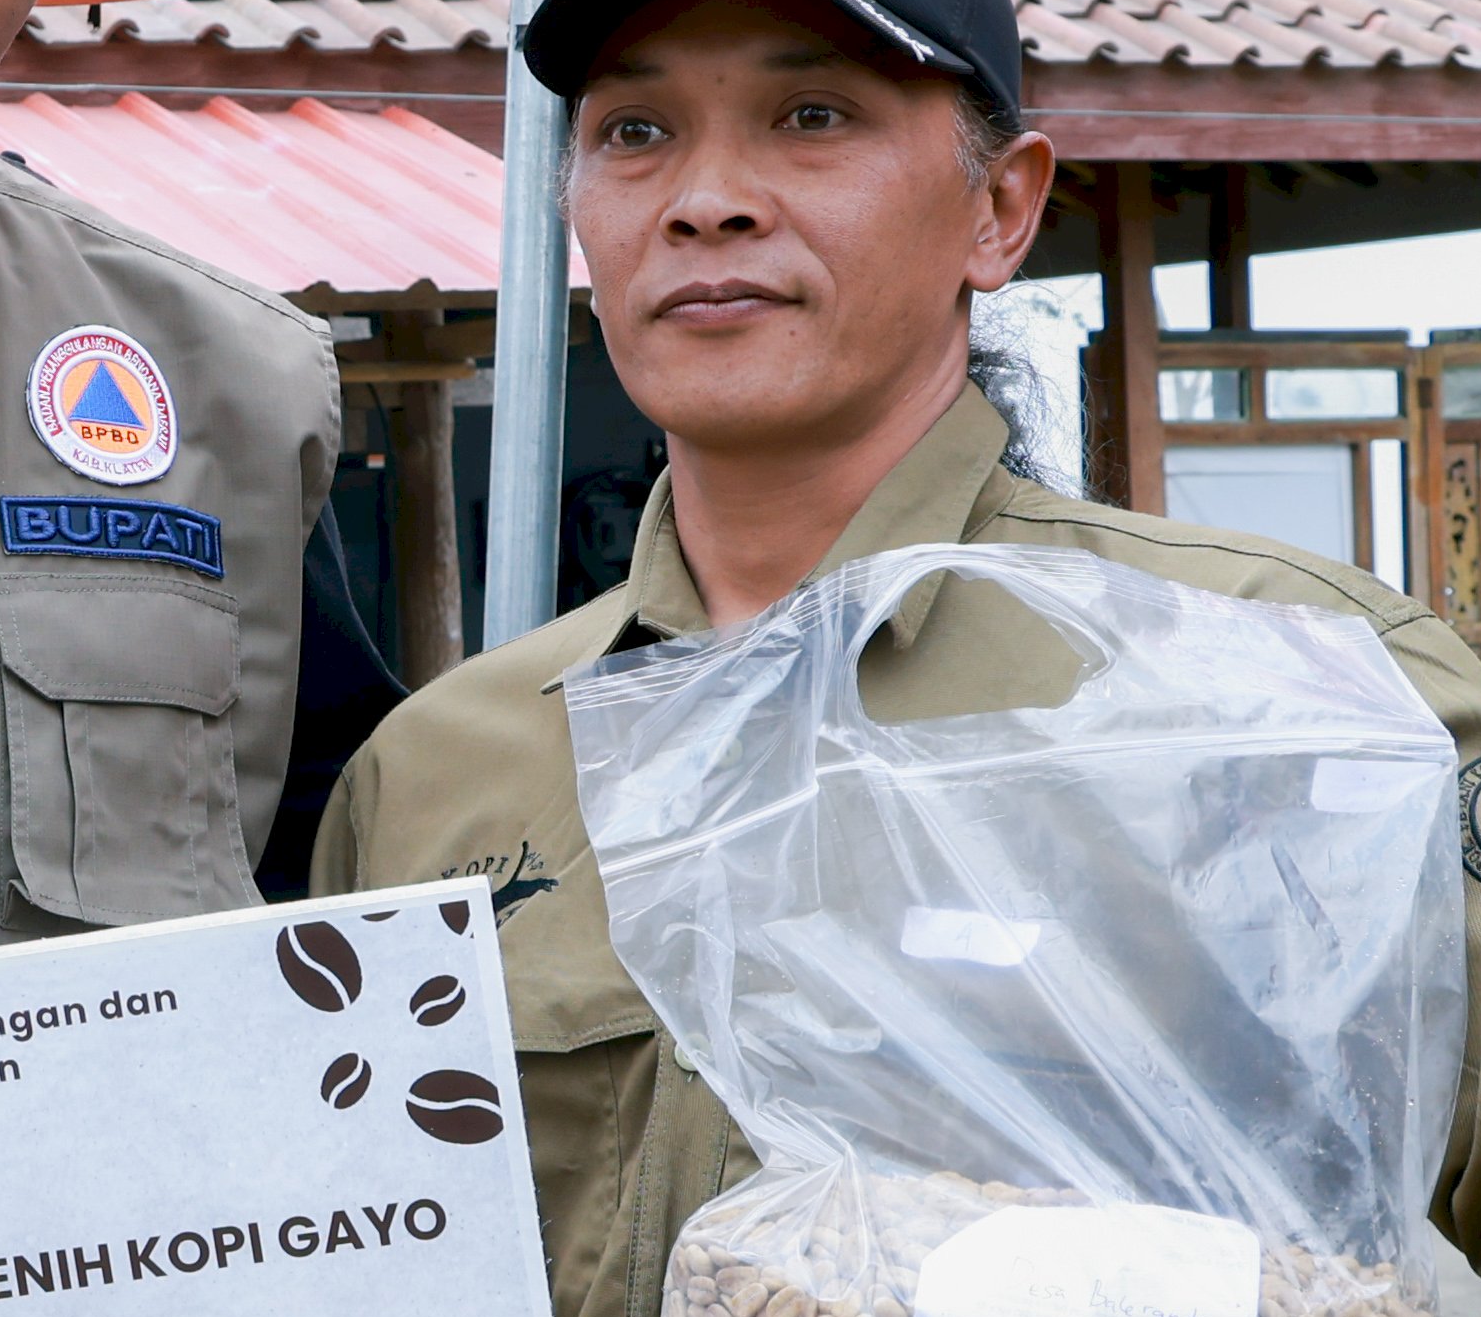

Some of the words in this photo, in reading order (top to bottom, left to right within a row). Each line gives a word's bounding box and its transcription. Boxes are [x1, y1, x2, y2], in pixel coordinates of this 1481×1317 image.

[81, 426, 139, 445] BPBD
[15, 505, 210, 559] BUPATI
[99, 989, 177, 1020] dan
[127, 1222, 264, 1281] KOPI
[278, 1198, 447, 1258] GAYO
